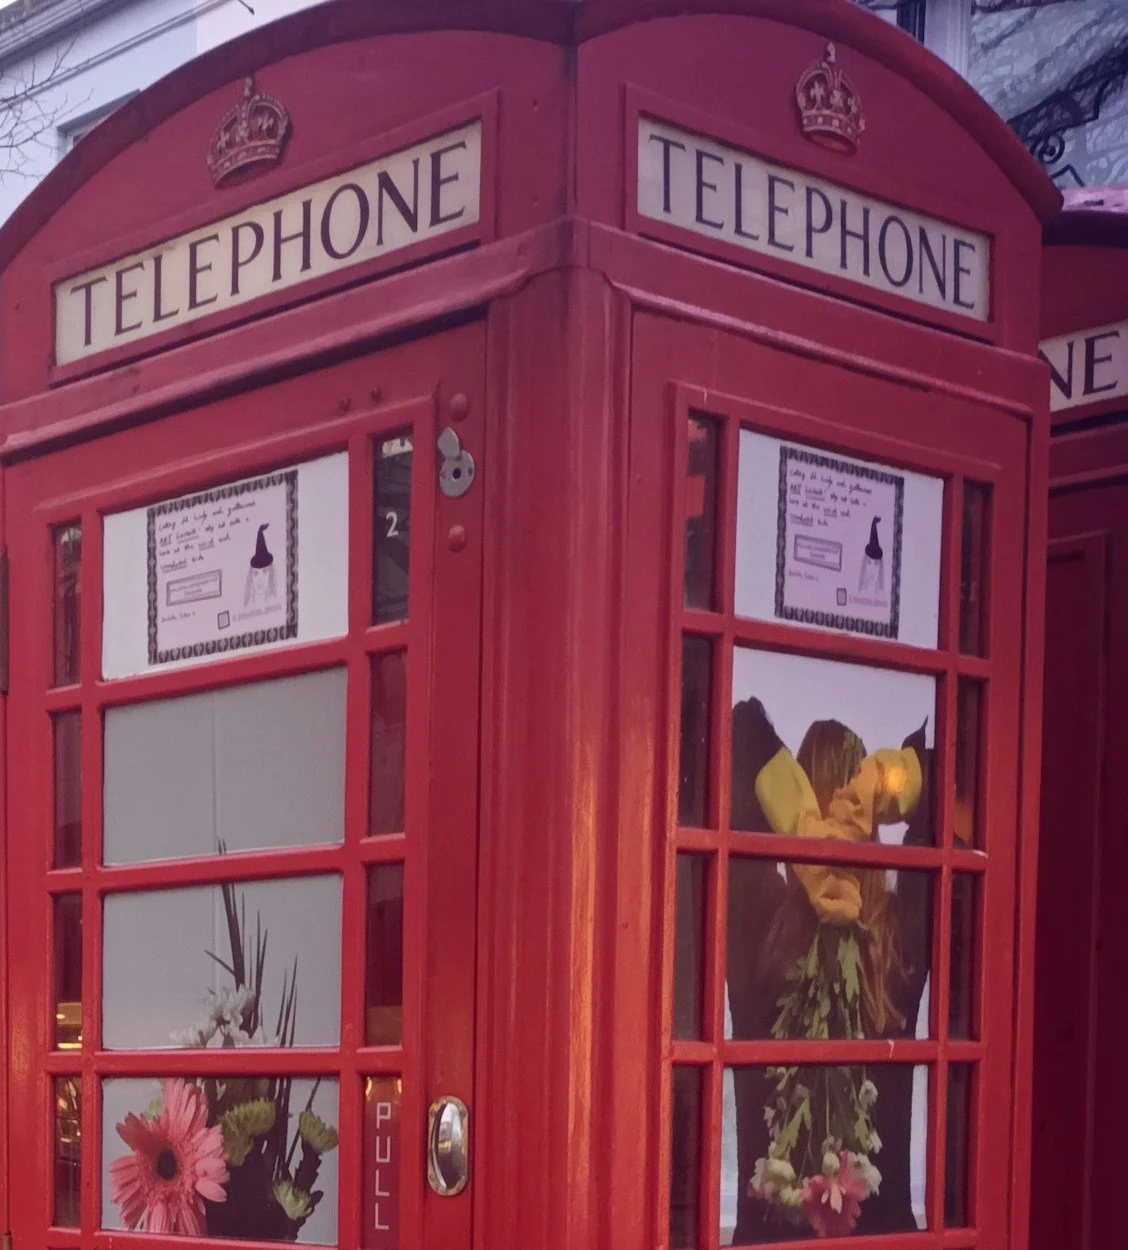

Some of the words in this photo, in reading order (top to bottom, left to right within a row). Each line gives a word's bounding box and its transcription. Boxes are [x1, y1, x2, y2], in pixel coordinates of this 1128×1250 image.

[71, 141, 467, 347] TELEPHONE
[648, 134, 976, 310] TELEPHONE
[1038, 330, 1119, 399] NE
[386, 511, 399, 537] 2
[374, 1102, 392, 1230] PULL
